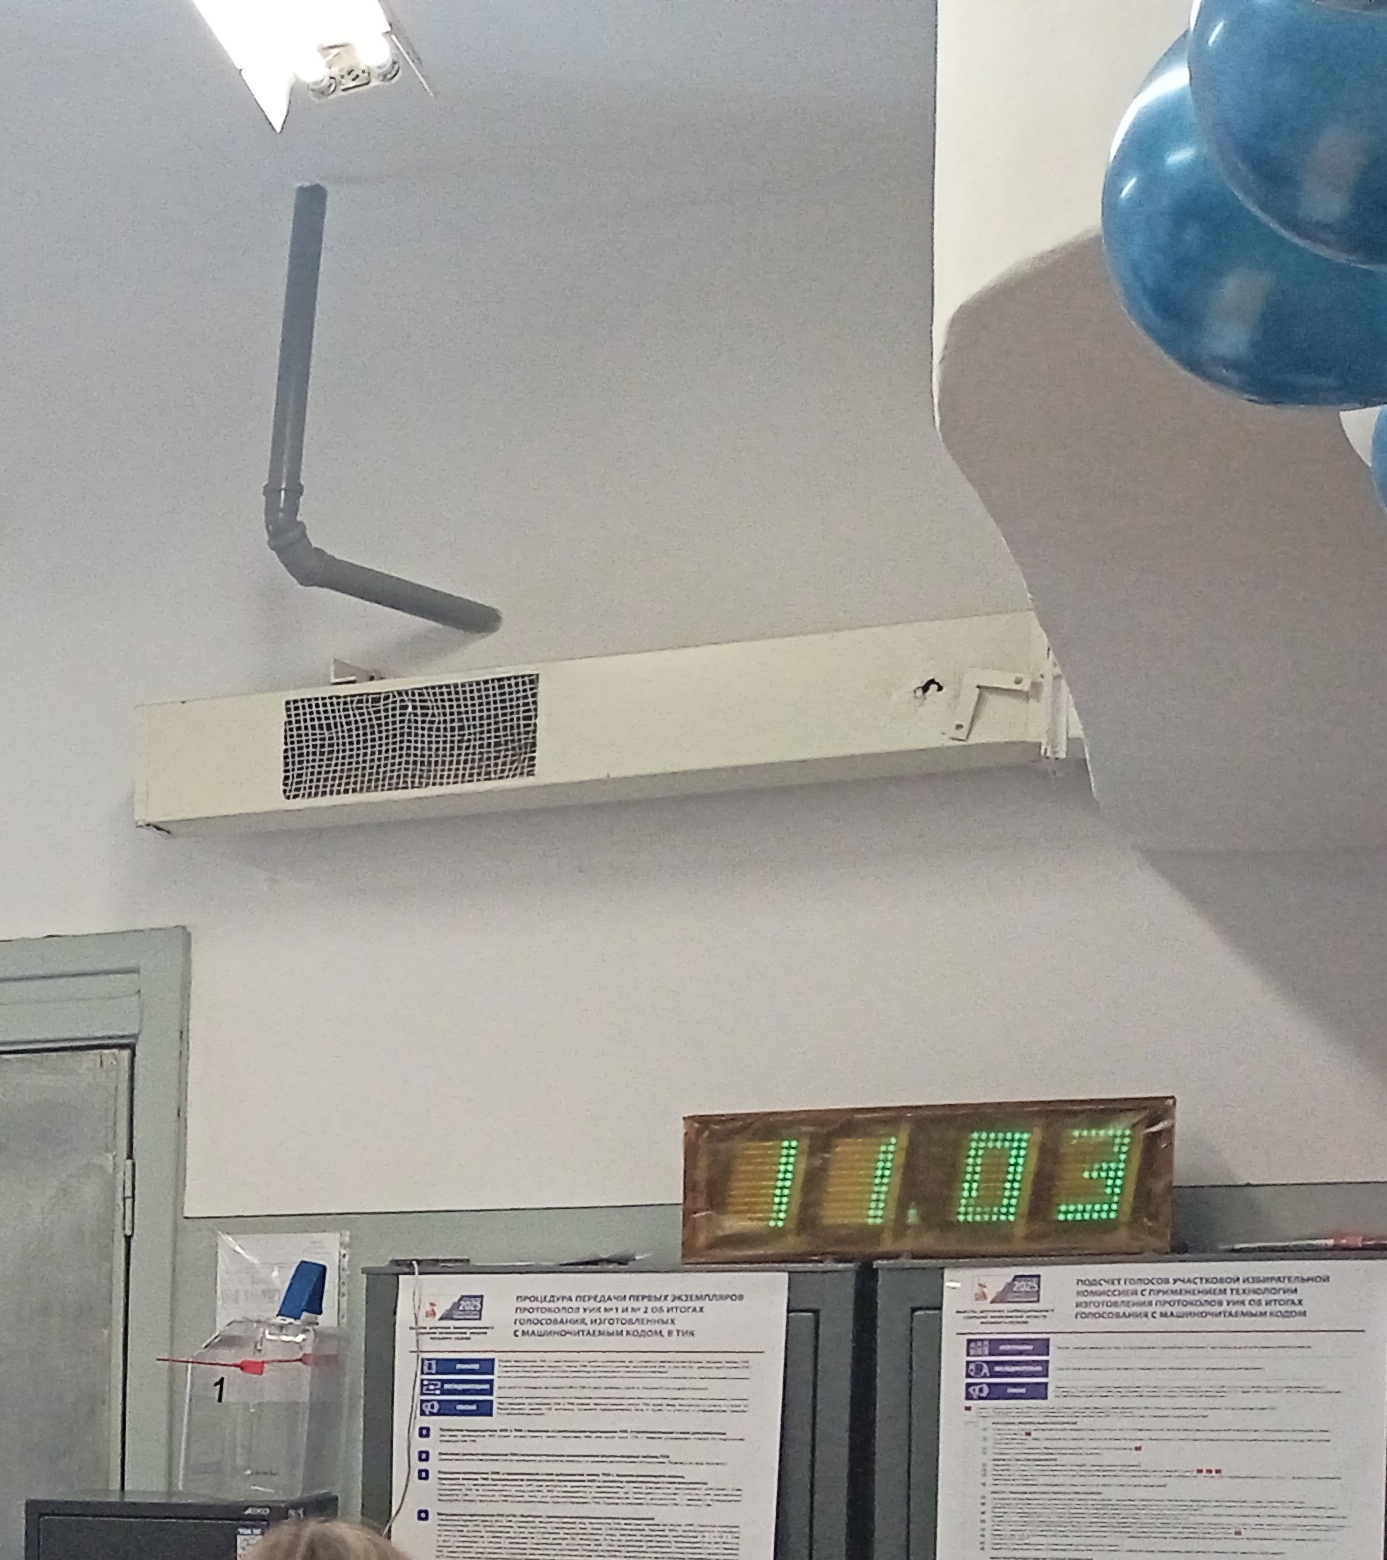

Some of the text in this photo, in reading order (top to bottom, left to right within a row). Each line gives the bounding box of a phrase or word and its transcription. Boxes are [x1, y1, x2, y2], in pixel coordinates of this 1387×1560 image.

[1076, 1278, 1122, 1286] ПОДСЧЕТ
[1124, 1277, 1170, 1285] ГОЛОСОВ
[1172, 1276, 1240, 1285] УЧАСТКОВОЙ
[516, 1294, 573, 1303] ПРОЦЕДУРА
[575, 1294, 626, 1303] ПЕРЕДАЧИ
[629, 1294, 669, 1302] ПЕРВЫХ
[515, 1306, 580, 1314] ПРОТОКОЛОВ
[667, 1306, 704, 1314] ИТОГАХ
[213, 1376, 225, 1403] 1
